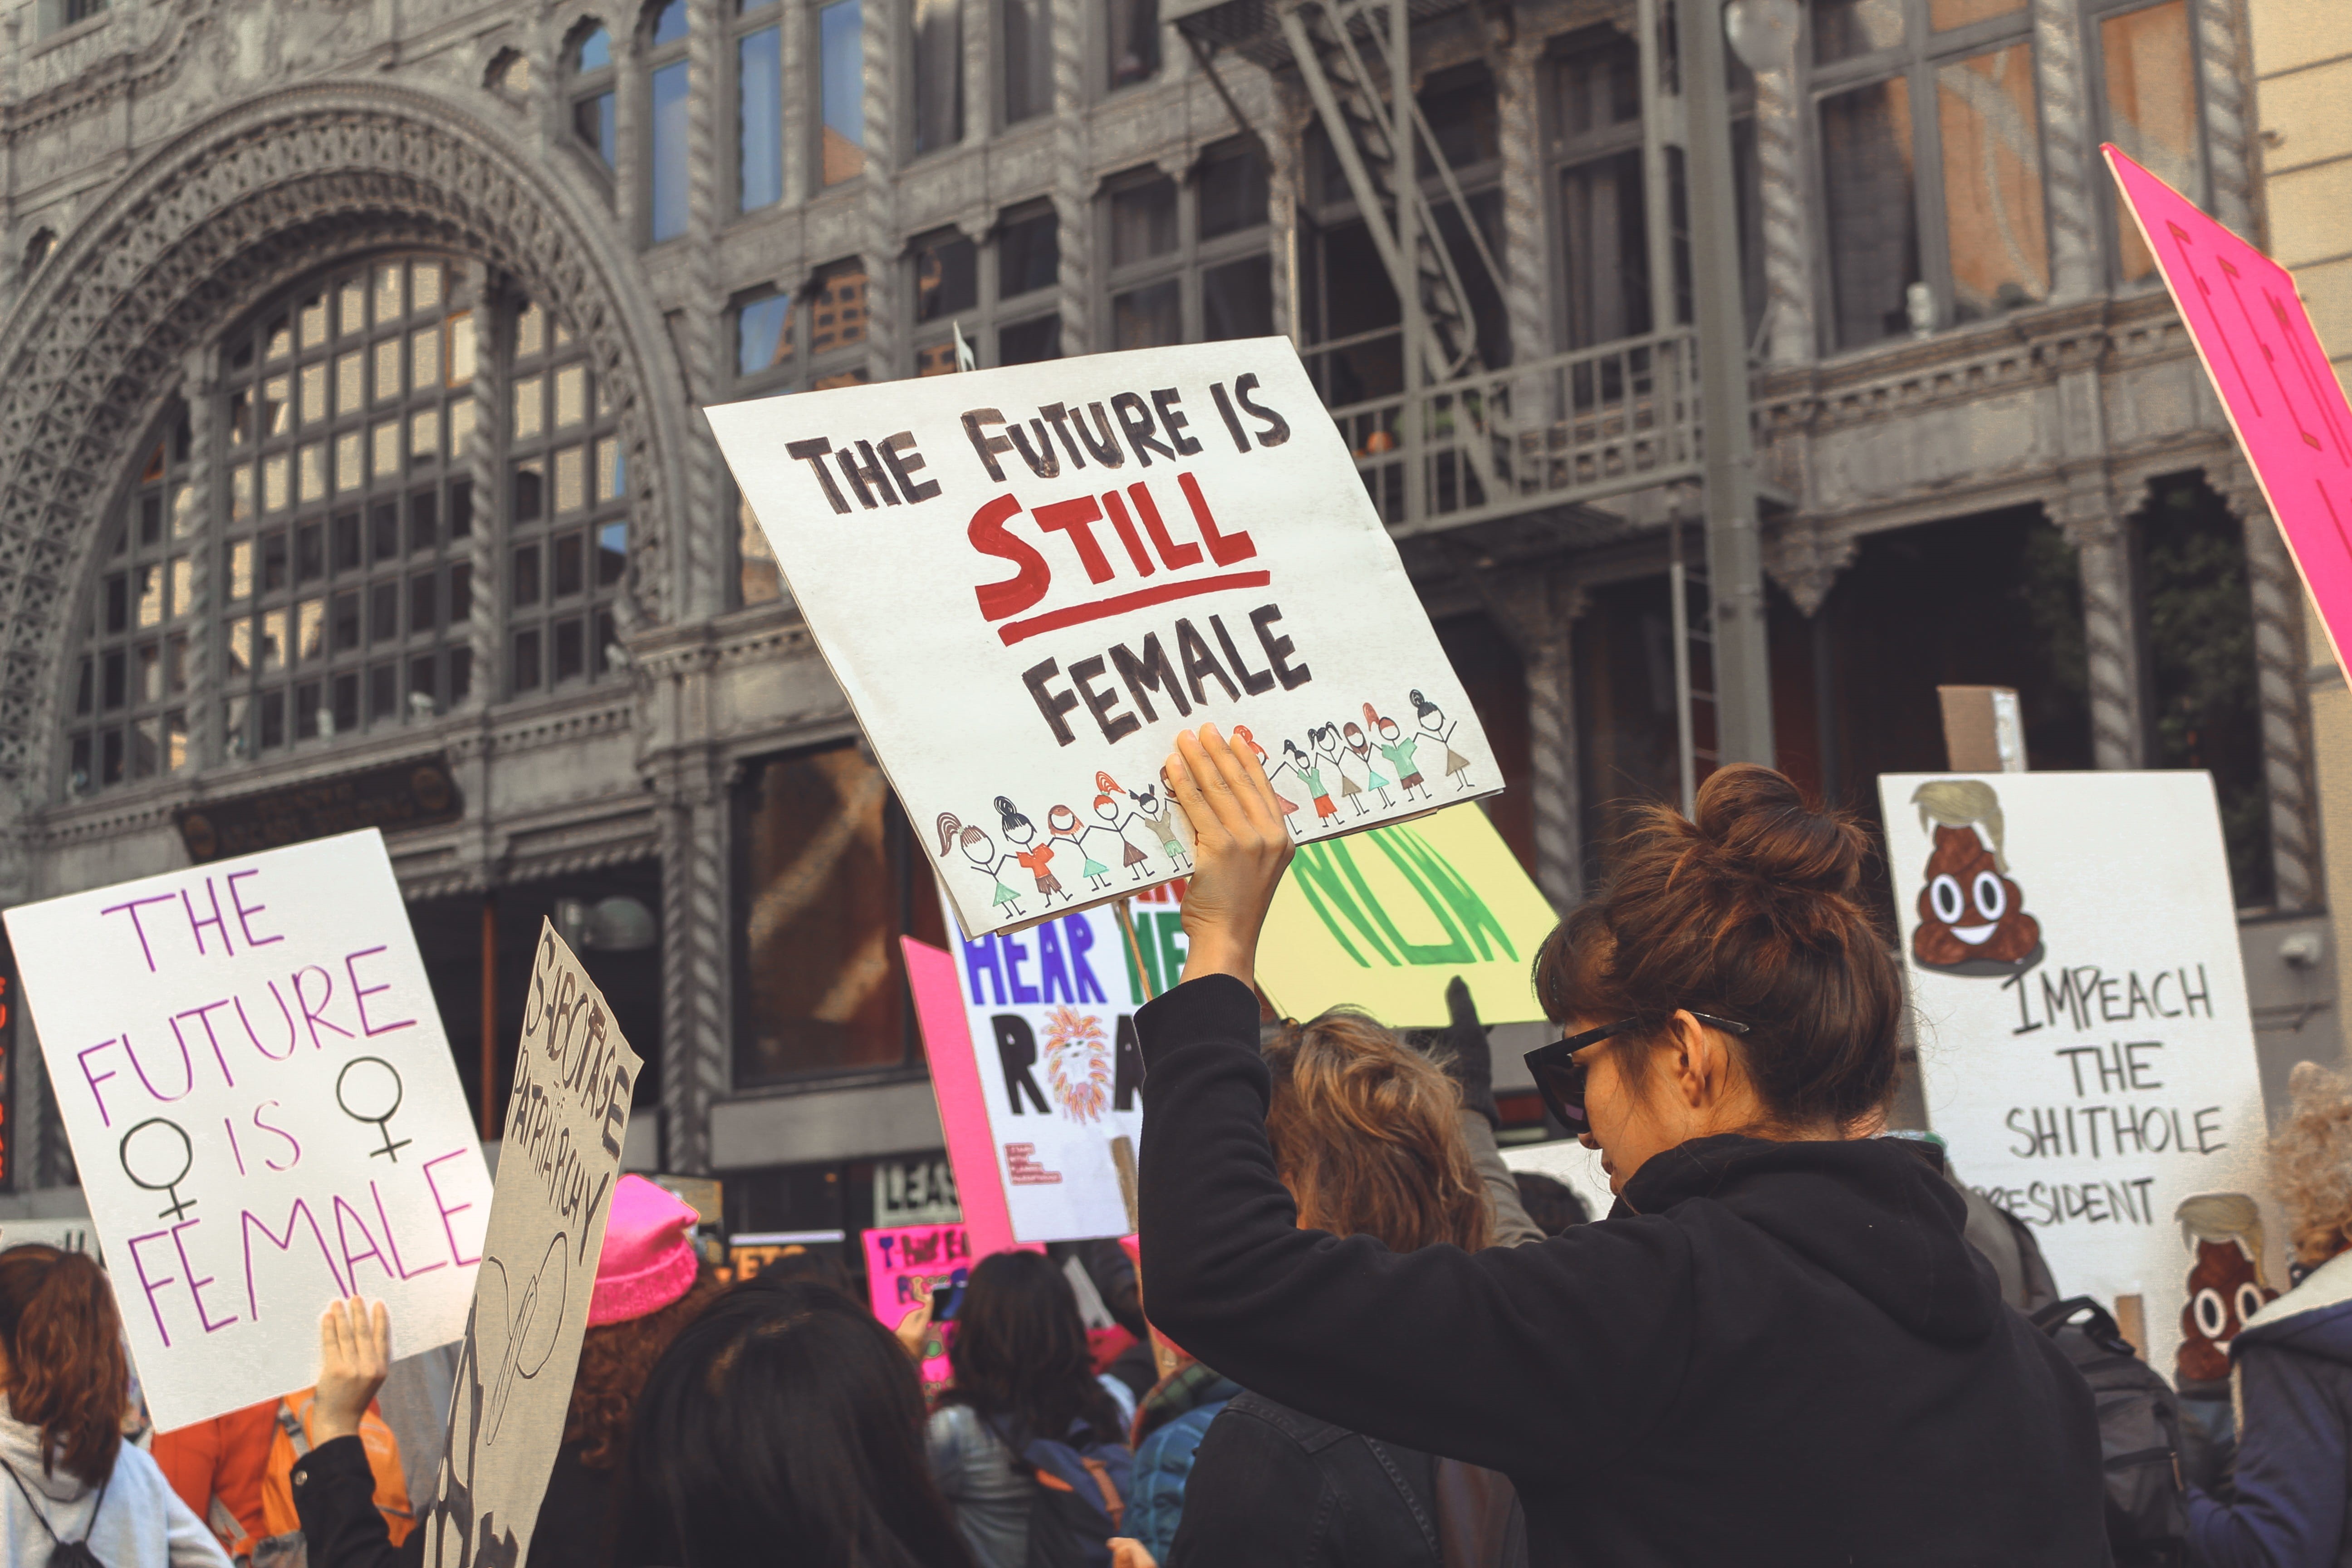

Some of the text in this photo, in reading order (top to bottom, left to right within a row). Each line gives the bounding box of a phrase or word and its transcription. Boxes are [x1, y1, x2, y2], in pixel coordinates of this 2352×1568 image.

[784, 372, 1291, 514] THE FUTURE IS
[967, 471, 1258, 622] STILL
[1021, 603, 1312, 747] FEMALE
[101, 869, 284, 972] THE
[960, 912, 1107, 1005] HEAR
[77, 945, 417, 1128] FUTURE
[524, 929, 631, 1162] SABOTAGE
[2000, 963, 2212, 1036] IMPEACH
[2056, 1041, 2165, 1098] THE
[224, 1100, 302, 1176] IS
[511, 1044, 611, 1266] PATRIARCHY
[2006, 1106, 2229, 1159] SHITHOLE
[128, 1148, 482, 1348] FEMALE
